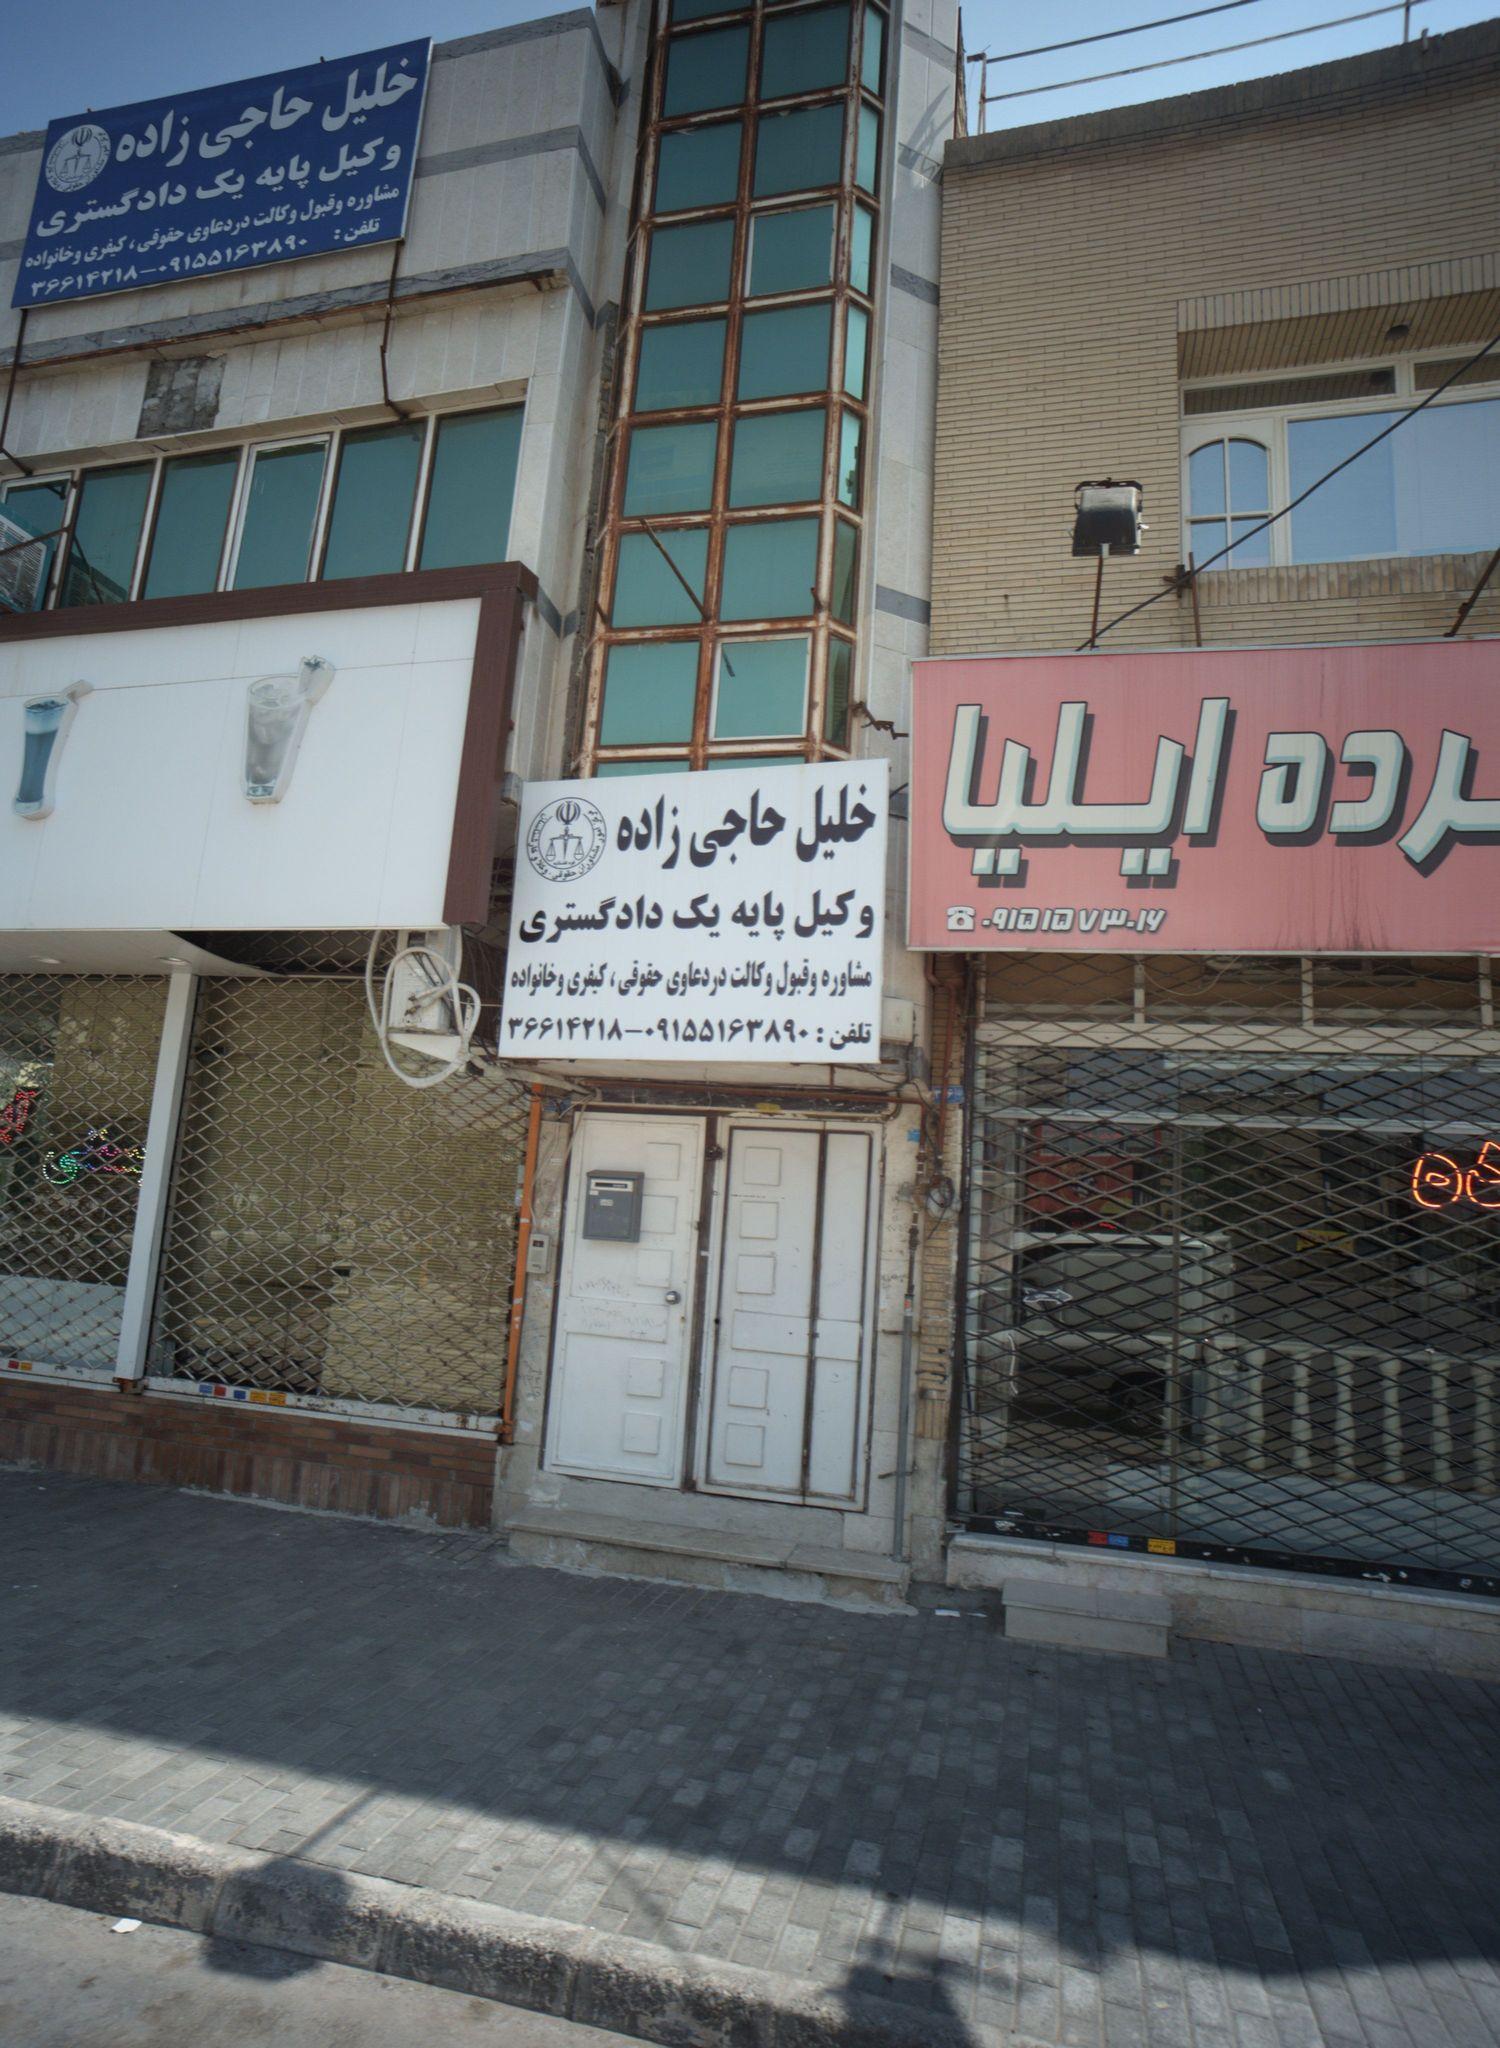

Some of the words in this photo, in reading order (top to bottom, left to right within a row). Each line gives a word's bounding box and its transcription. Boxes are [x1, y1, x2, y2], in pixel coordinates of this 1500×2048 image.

[322, 57, 418, 132] خلیل
[115, 110, 191, 167] زاده
[198, 85, 314, 159] حاجی
[256, 154, 310, 191] پایه
[318, 136, 401, 182] وکیل
[195, 168, 246, 200] یک
[347, 184, 400, 211] مشاوره
[36, 181, 188, 237] دادگستری
[253, 204, 297, 227] وکالت
[84, 235, 128, 263] کیفری
[941, 696, 1232, 877] ایلیا
[1255, 728, 1500, 864] رده
[617, 793, 681, 870] زاده
[689, 788, 786, 868] حاجی
[796, 783, 877, 863] خلیل
[519, 894, 663, 943] دادگستری
[672, 893, 720, 938] یک
[731, 890, 785, 941] پایه
[794, 889, 874, 938] وکیل
[567, 962, 608, 997] کیفری
[730, 960, 773, 997] وکالت
[821, 959, 873, 997] مشاوره
